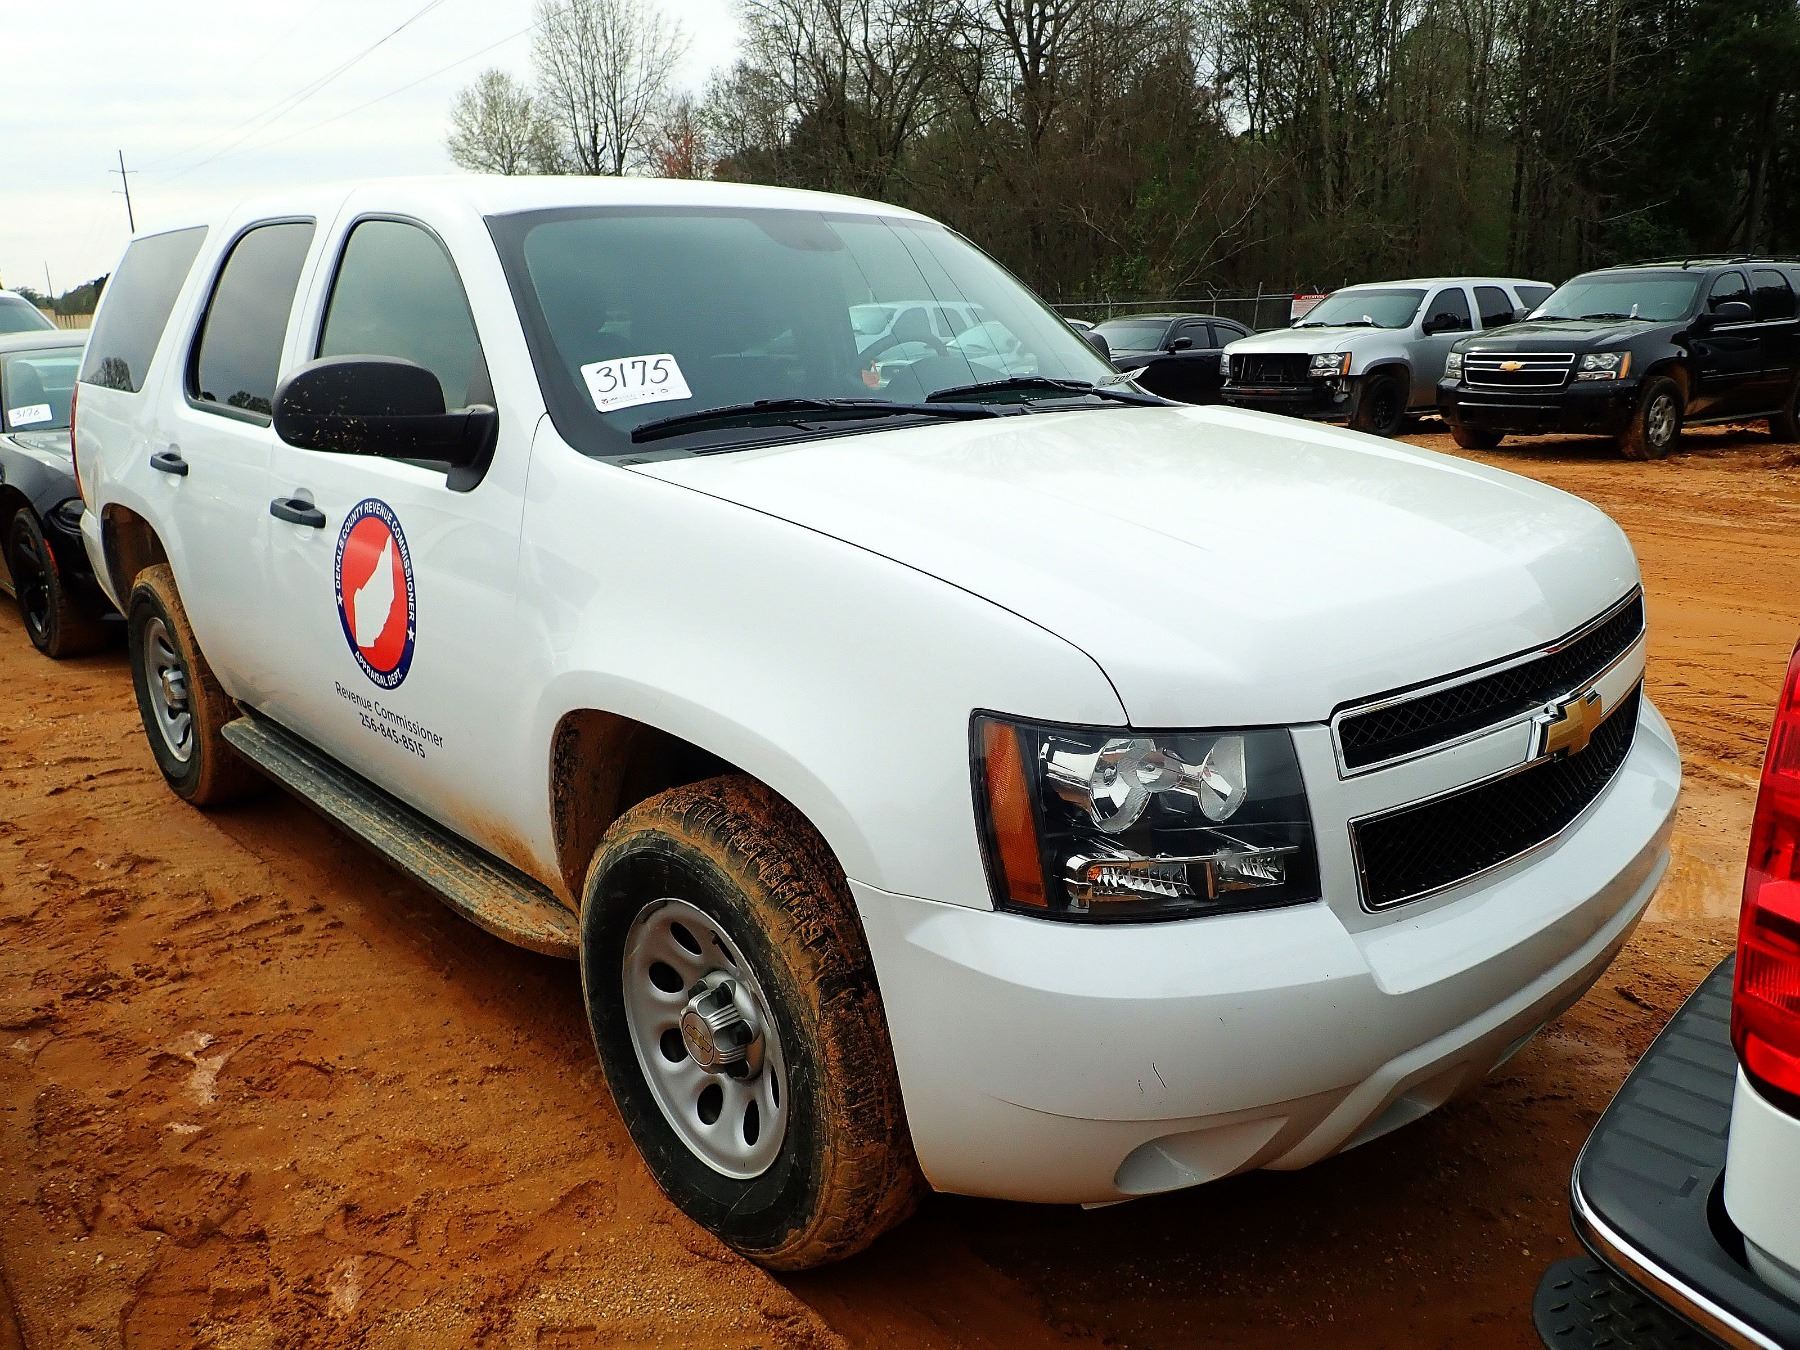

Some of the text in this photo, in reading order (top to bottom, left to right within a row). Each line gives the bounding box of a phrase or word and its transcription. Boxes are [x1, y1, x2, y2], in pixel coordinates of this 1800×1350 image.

[596, 358, 672, 393] 3175
[335, 501, 416, 622] DEKALB COUNTY REVENUE COMMISSIONER
[354, 650, 389, 687] APPRAISAL
[335, 681, 444, 749] Revenue Commissioner
[359, 711, 426, 759] 256-845-8515
